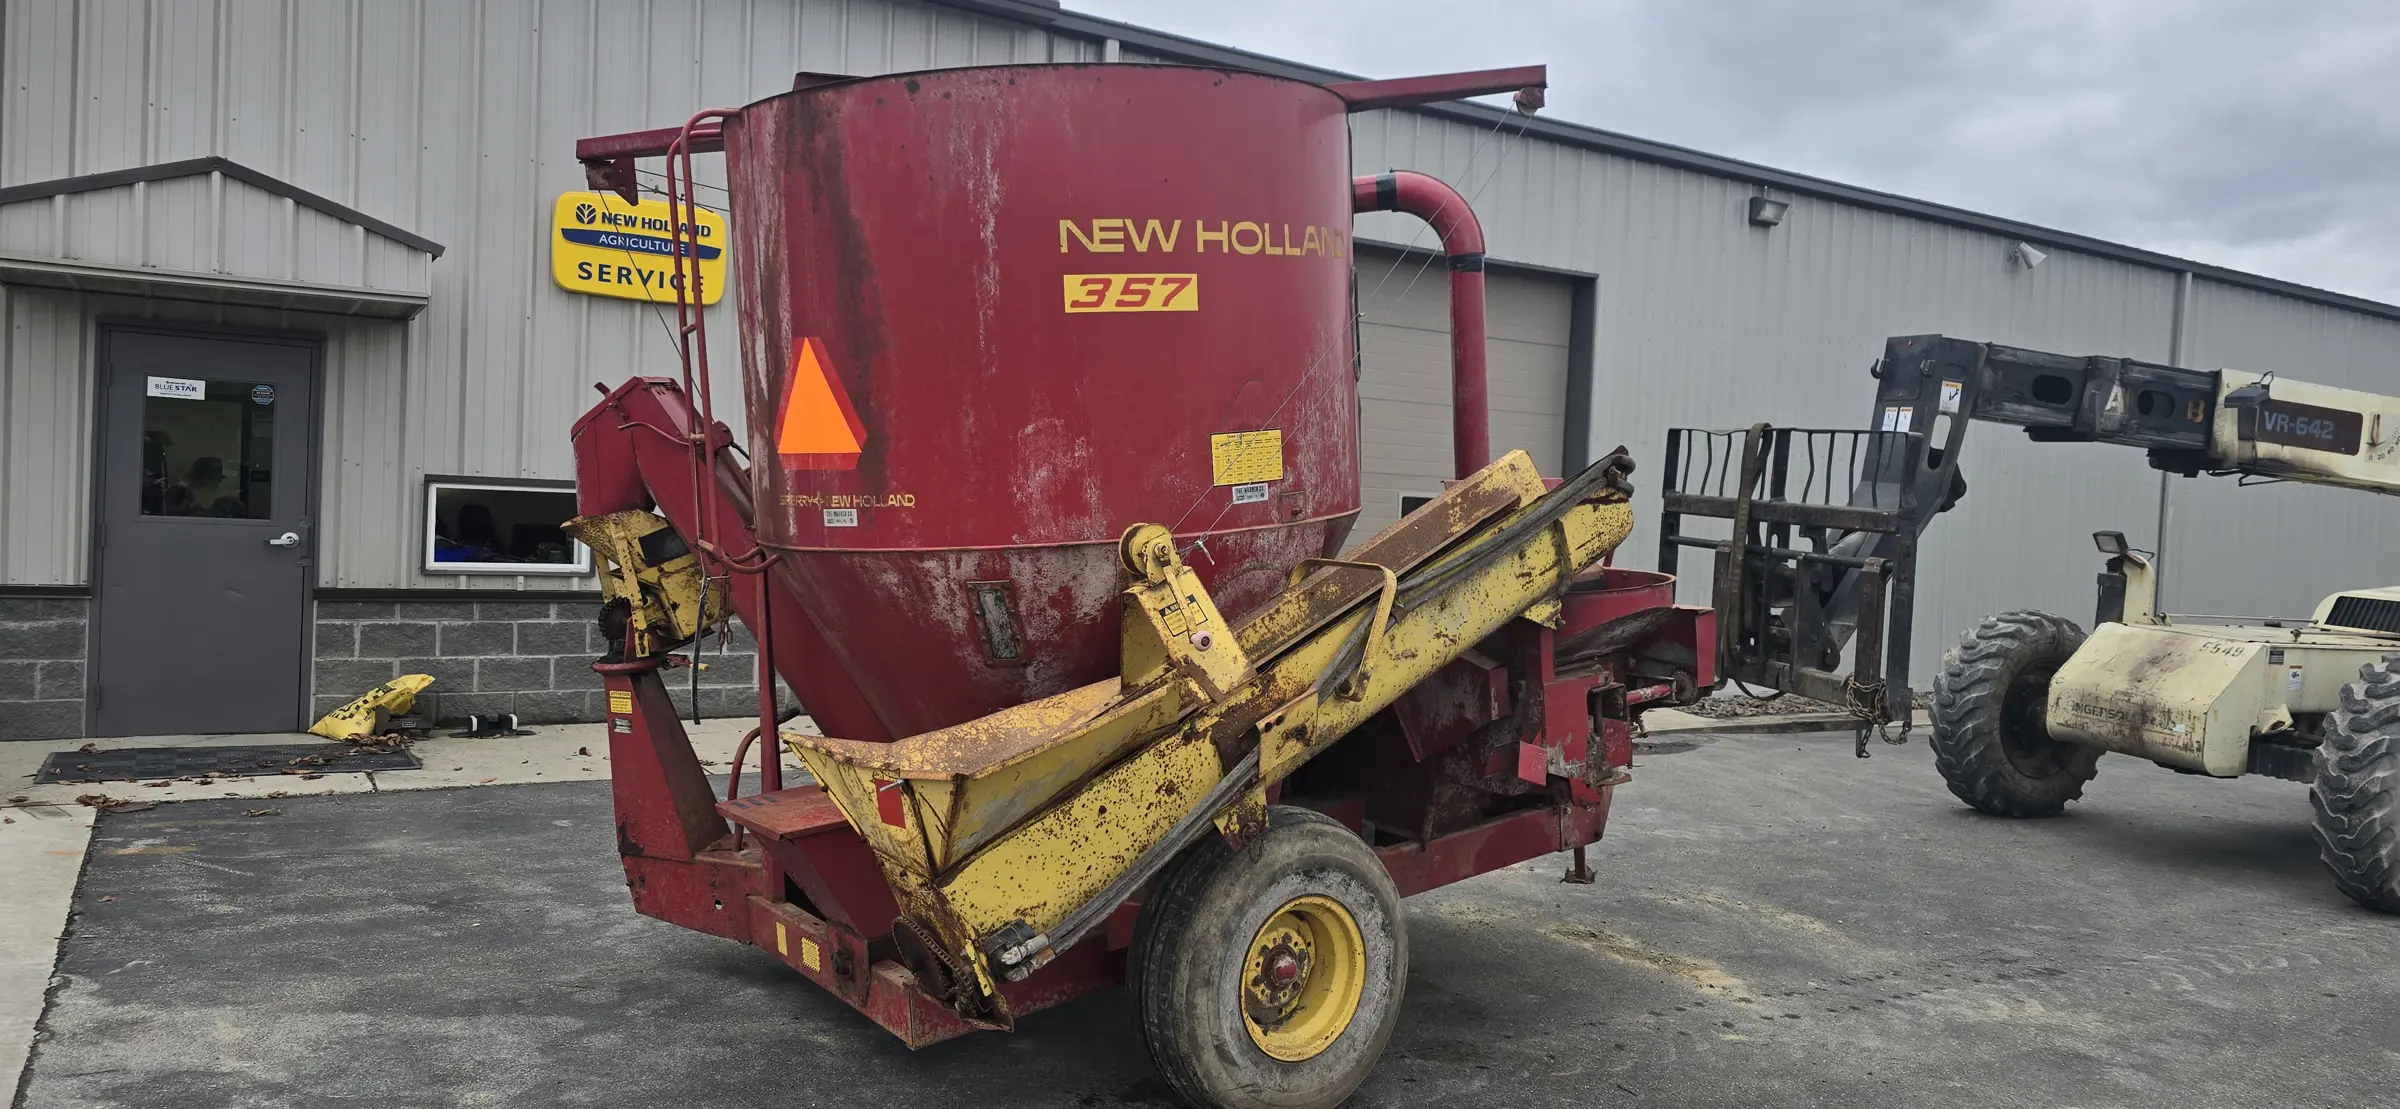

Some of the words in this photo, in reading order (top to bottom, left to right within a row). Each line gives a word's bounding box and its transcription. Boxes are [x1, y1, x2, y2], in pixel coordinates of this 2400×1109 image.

[601, 211, 638, 228] NEW
[641, 217, 711, 237] HOLAD
[599, 233, 686, 254] AGRICULTUE
[1059, 218, 1182, 253] NEW
[1196, 220, 1345, 259] HOLLAND
[1069, 277, 1193, 309] 357
[154, 383, 174, 391] BLUE
[174, 385, 198, 393] STAR
[2104, 384, 2125, 414] A
[2264, 410, 2335, 440] VR-642
[2387, 446, 2395, 455] 40
[852, 494, 916, 508] HOLLAND
